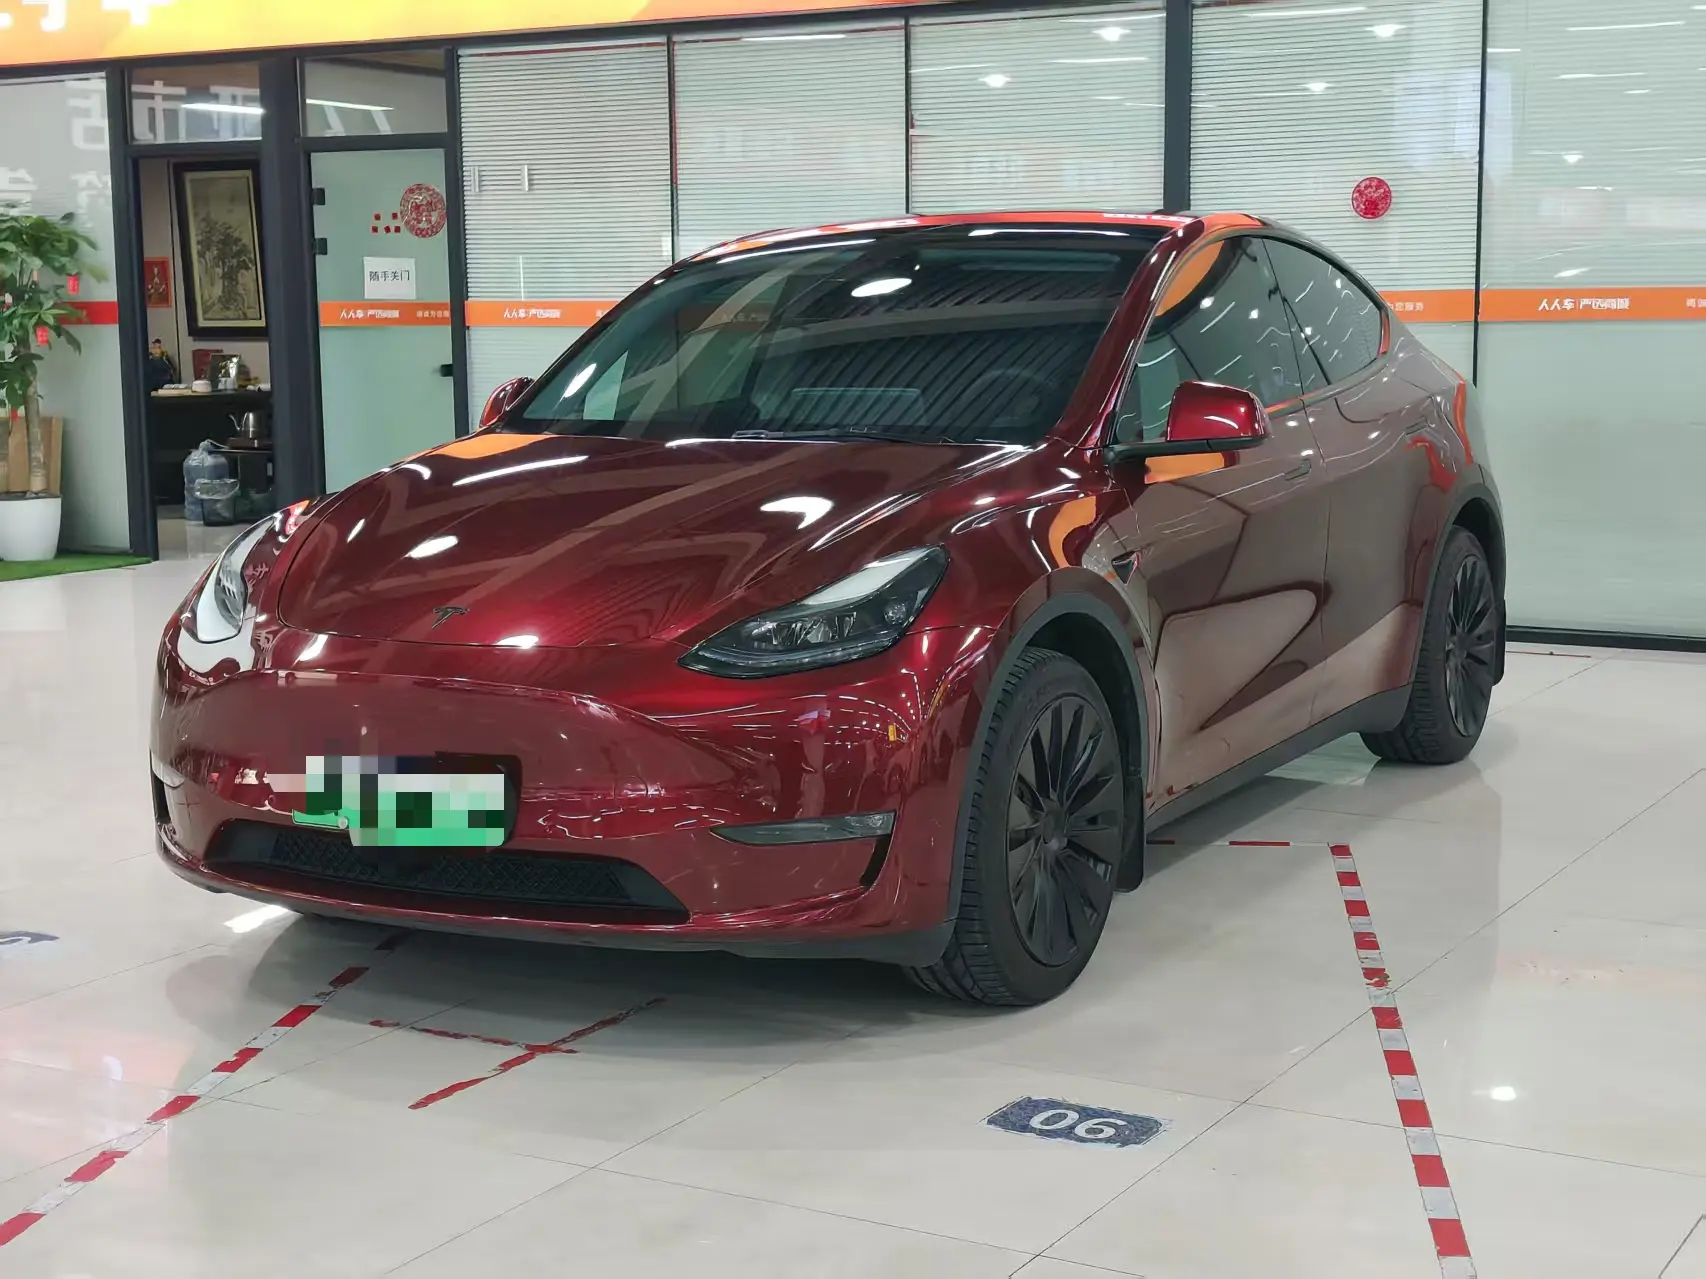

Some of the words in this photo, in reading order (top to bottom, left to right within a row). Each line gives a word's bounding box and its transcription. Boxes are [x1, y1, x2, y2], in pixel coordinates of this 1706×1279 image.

[369, 270, 410, 282] 随手关门
[1537, 298, 1575, 311] 人人车
[340, 309, 364, 320] 人人车
[503, 308, 526, 319] 人人车
[1029, 1109, 1128, 1139] 06
